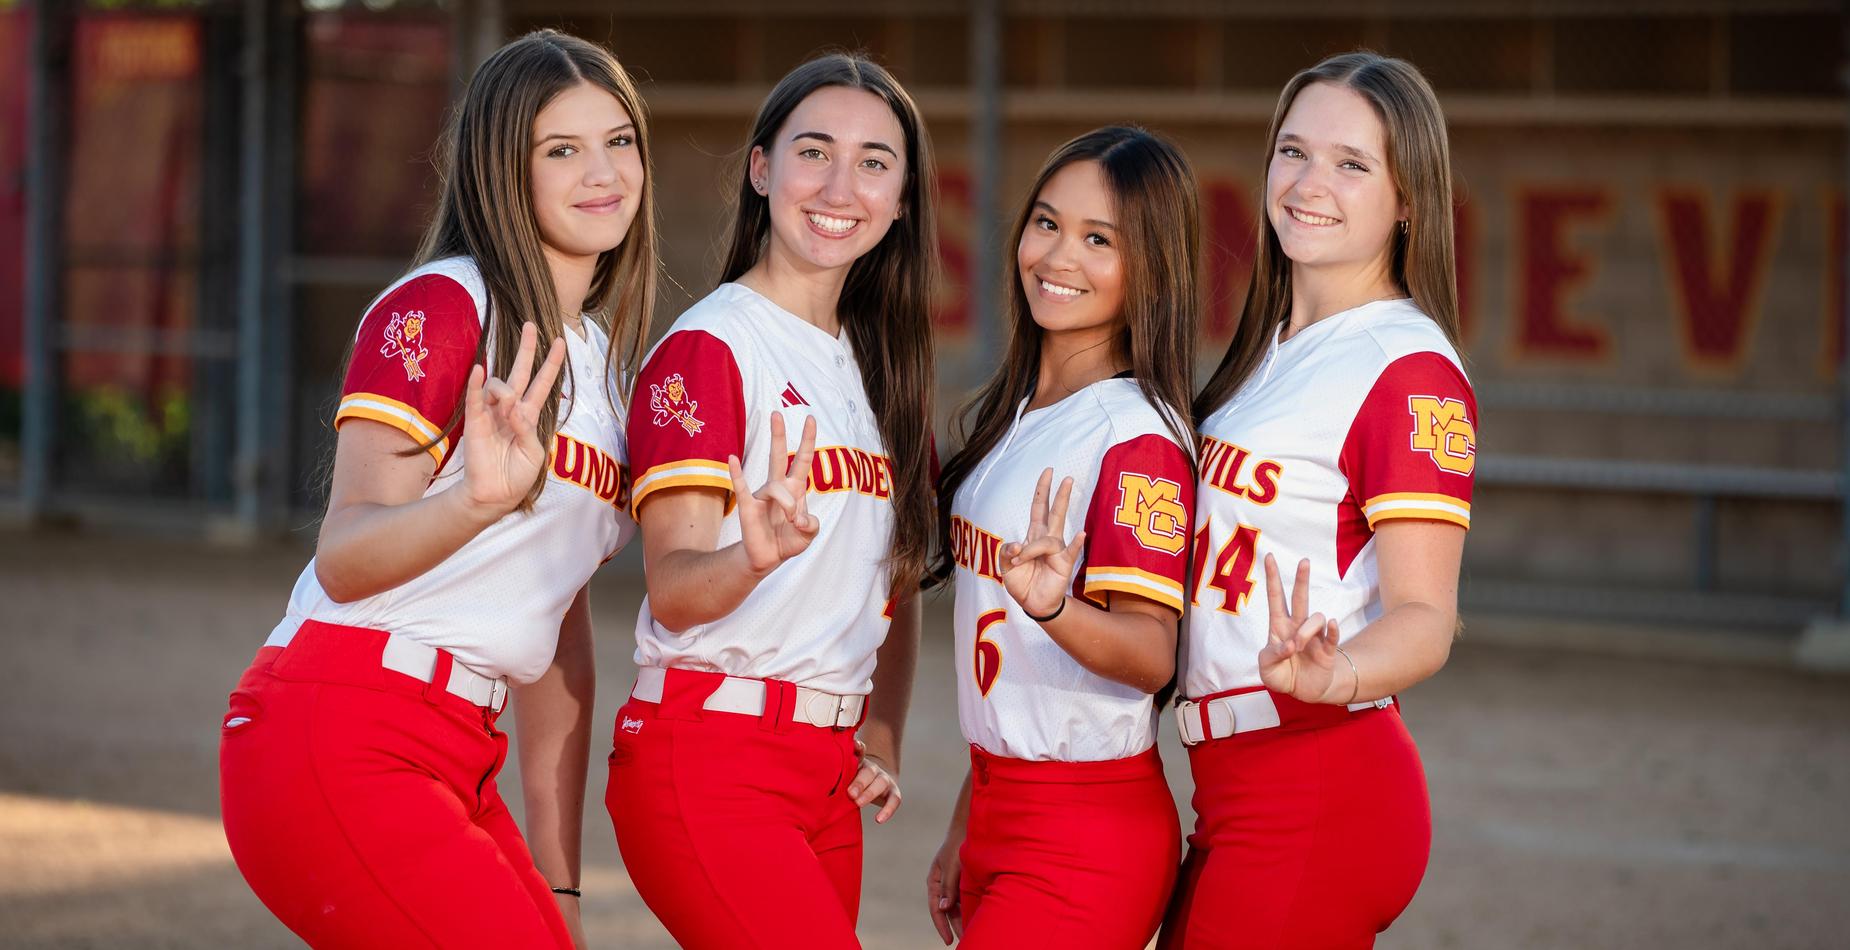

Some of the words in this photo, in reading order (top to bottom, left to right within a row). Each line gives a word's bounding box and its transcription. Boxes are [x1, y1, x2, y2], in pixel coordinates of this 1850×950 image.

[548, 432, 630, 512] UNDE
[1408, 395, 1476, 477] MC
[950, 514, 1004, 585] DEVIL
[1114, 471, 1187, 556] MC
[1191, 512, 1262, 616] 14
[974, 608, 1008, 700] 6
